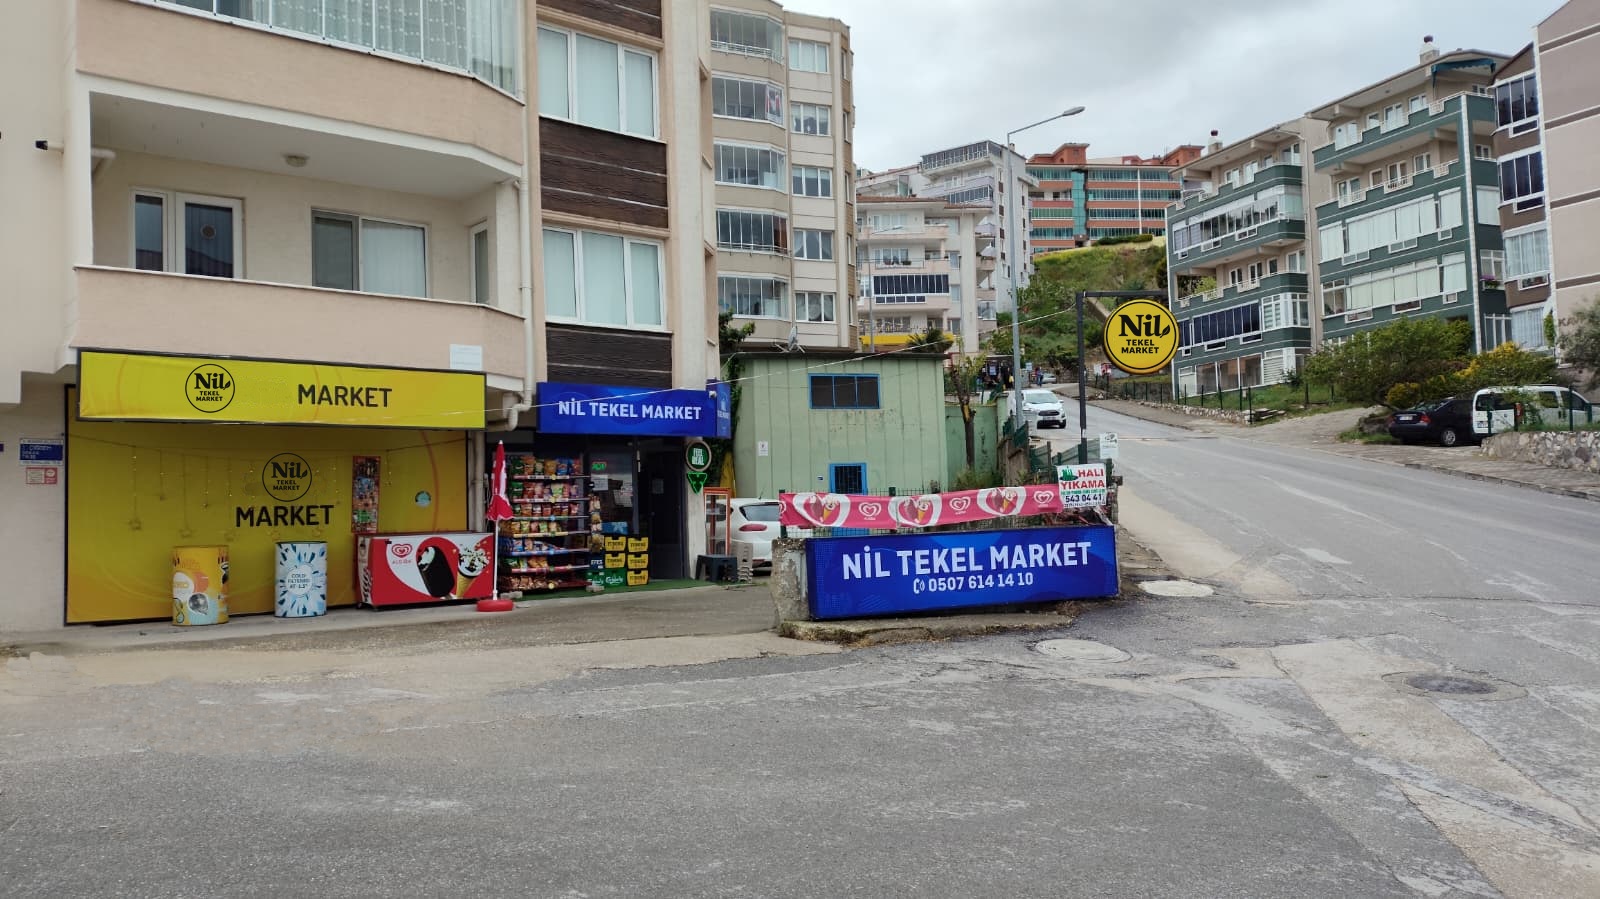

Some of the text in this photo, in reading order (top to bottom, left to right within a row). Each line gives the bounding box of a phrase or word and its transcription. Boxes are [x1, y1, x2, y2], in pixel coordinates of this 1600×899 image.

[1118, 314, 1162, 337] Nil
[1121, 346, 1160, 354] MARKET
[194, 372, 225, 390] Nil
[298, 383, 393, 408] MARKET
[558, 398, 586, 417] NİL
[589, 402, 639, 418] TEKEL
[642, 404, 703, 420] MARKET
[271, 461, 302, 479] Nil
[1078, 468, 1104, 478] HALI
[1060, 479, 1105, 490] YIKAMA
[1065, 494, 1080, 503] 543
[236, 504, 335, 528] MARKET
[842, 541, 1092, 580] NİL TEKEL MARKET
[928, 572, 1034, 593] 0507 614 14 10
